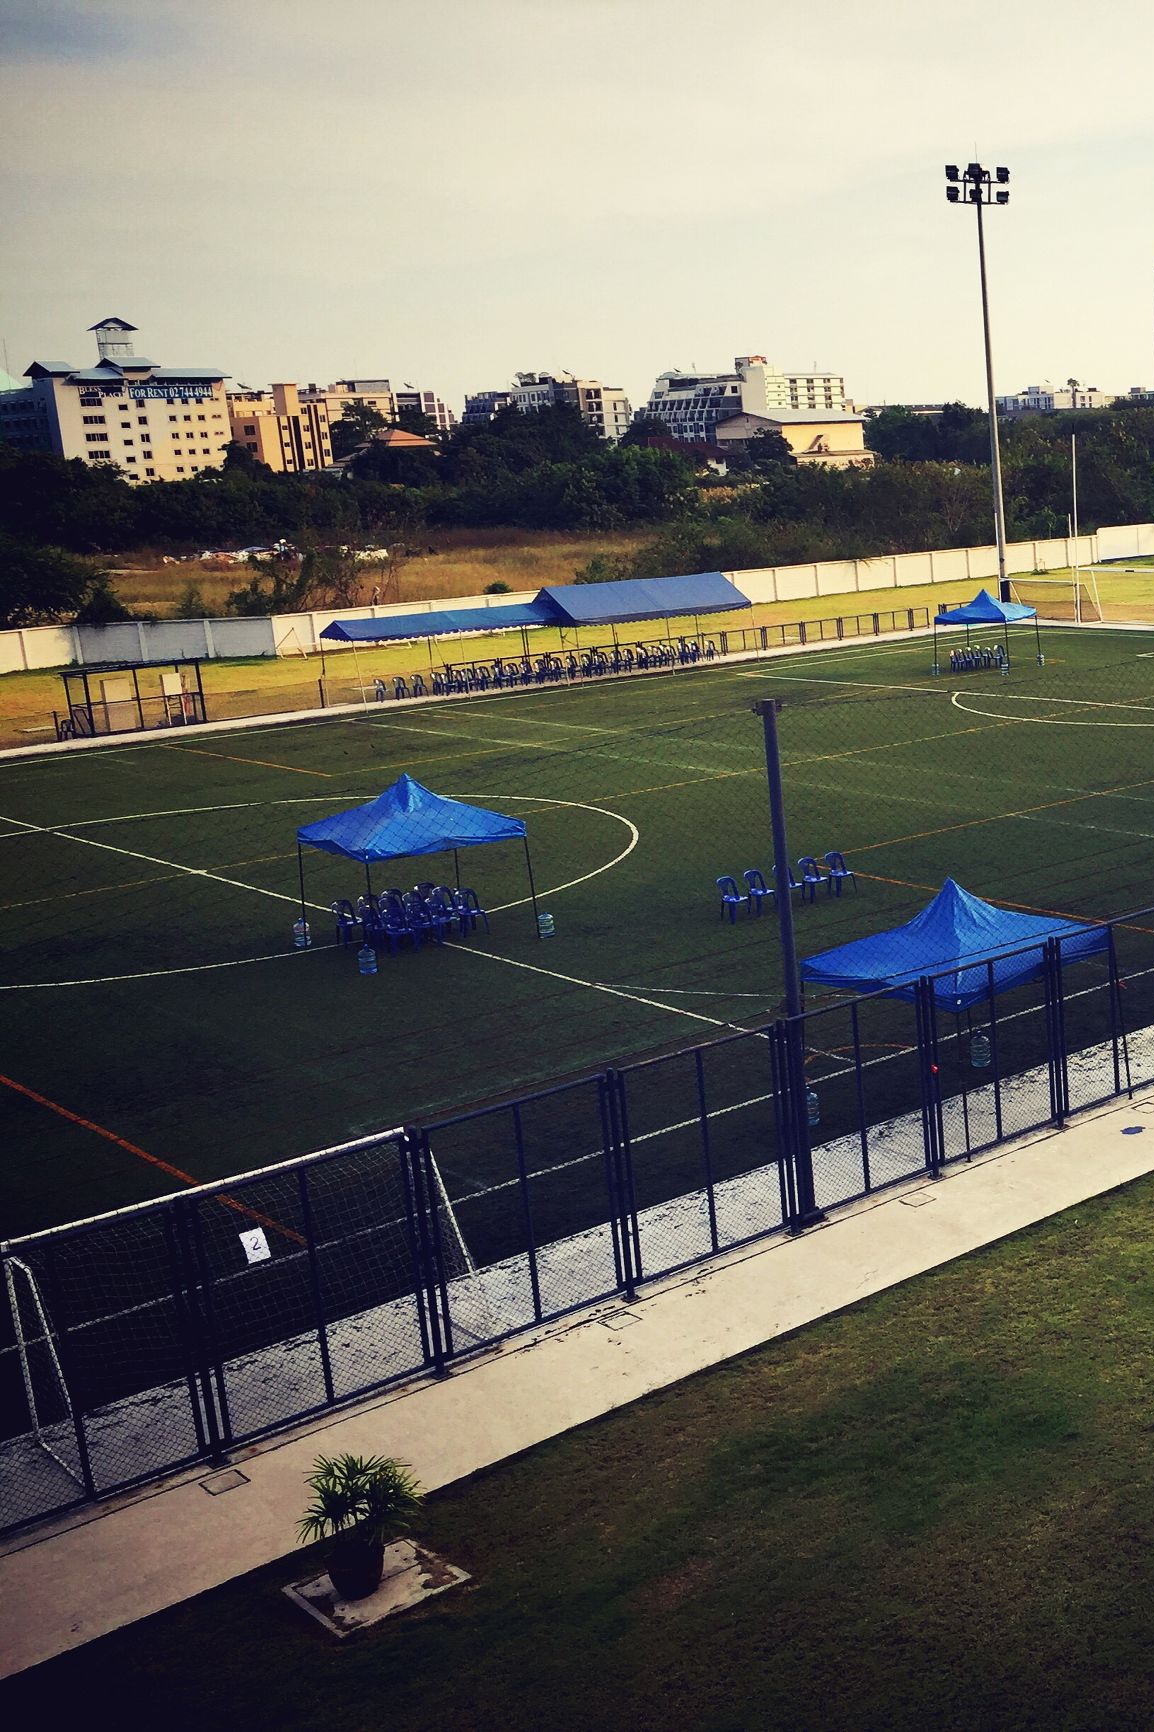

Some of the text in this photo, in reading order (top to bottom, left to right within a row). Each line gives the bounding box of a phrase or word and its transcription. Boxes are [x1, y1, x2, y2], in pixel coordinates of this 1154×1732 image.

[129, 387, 147, 398] FOR
[147, 387, 168, 398] RENT
[250, 1237, 261, 1250] 2
